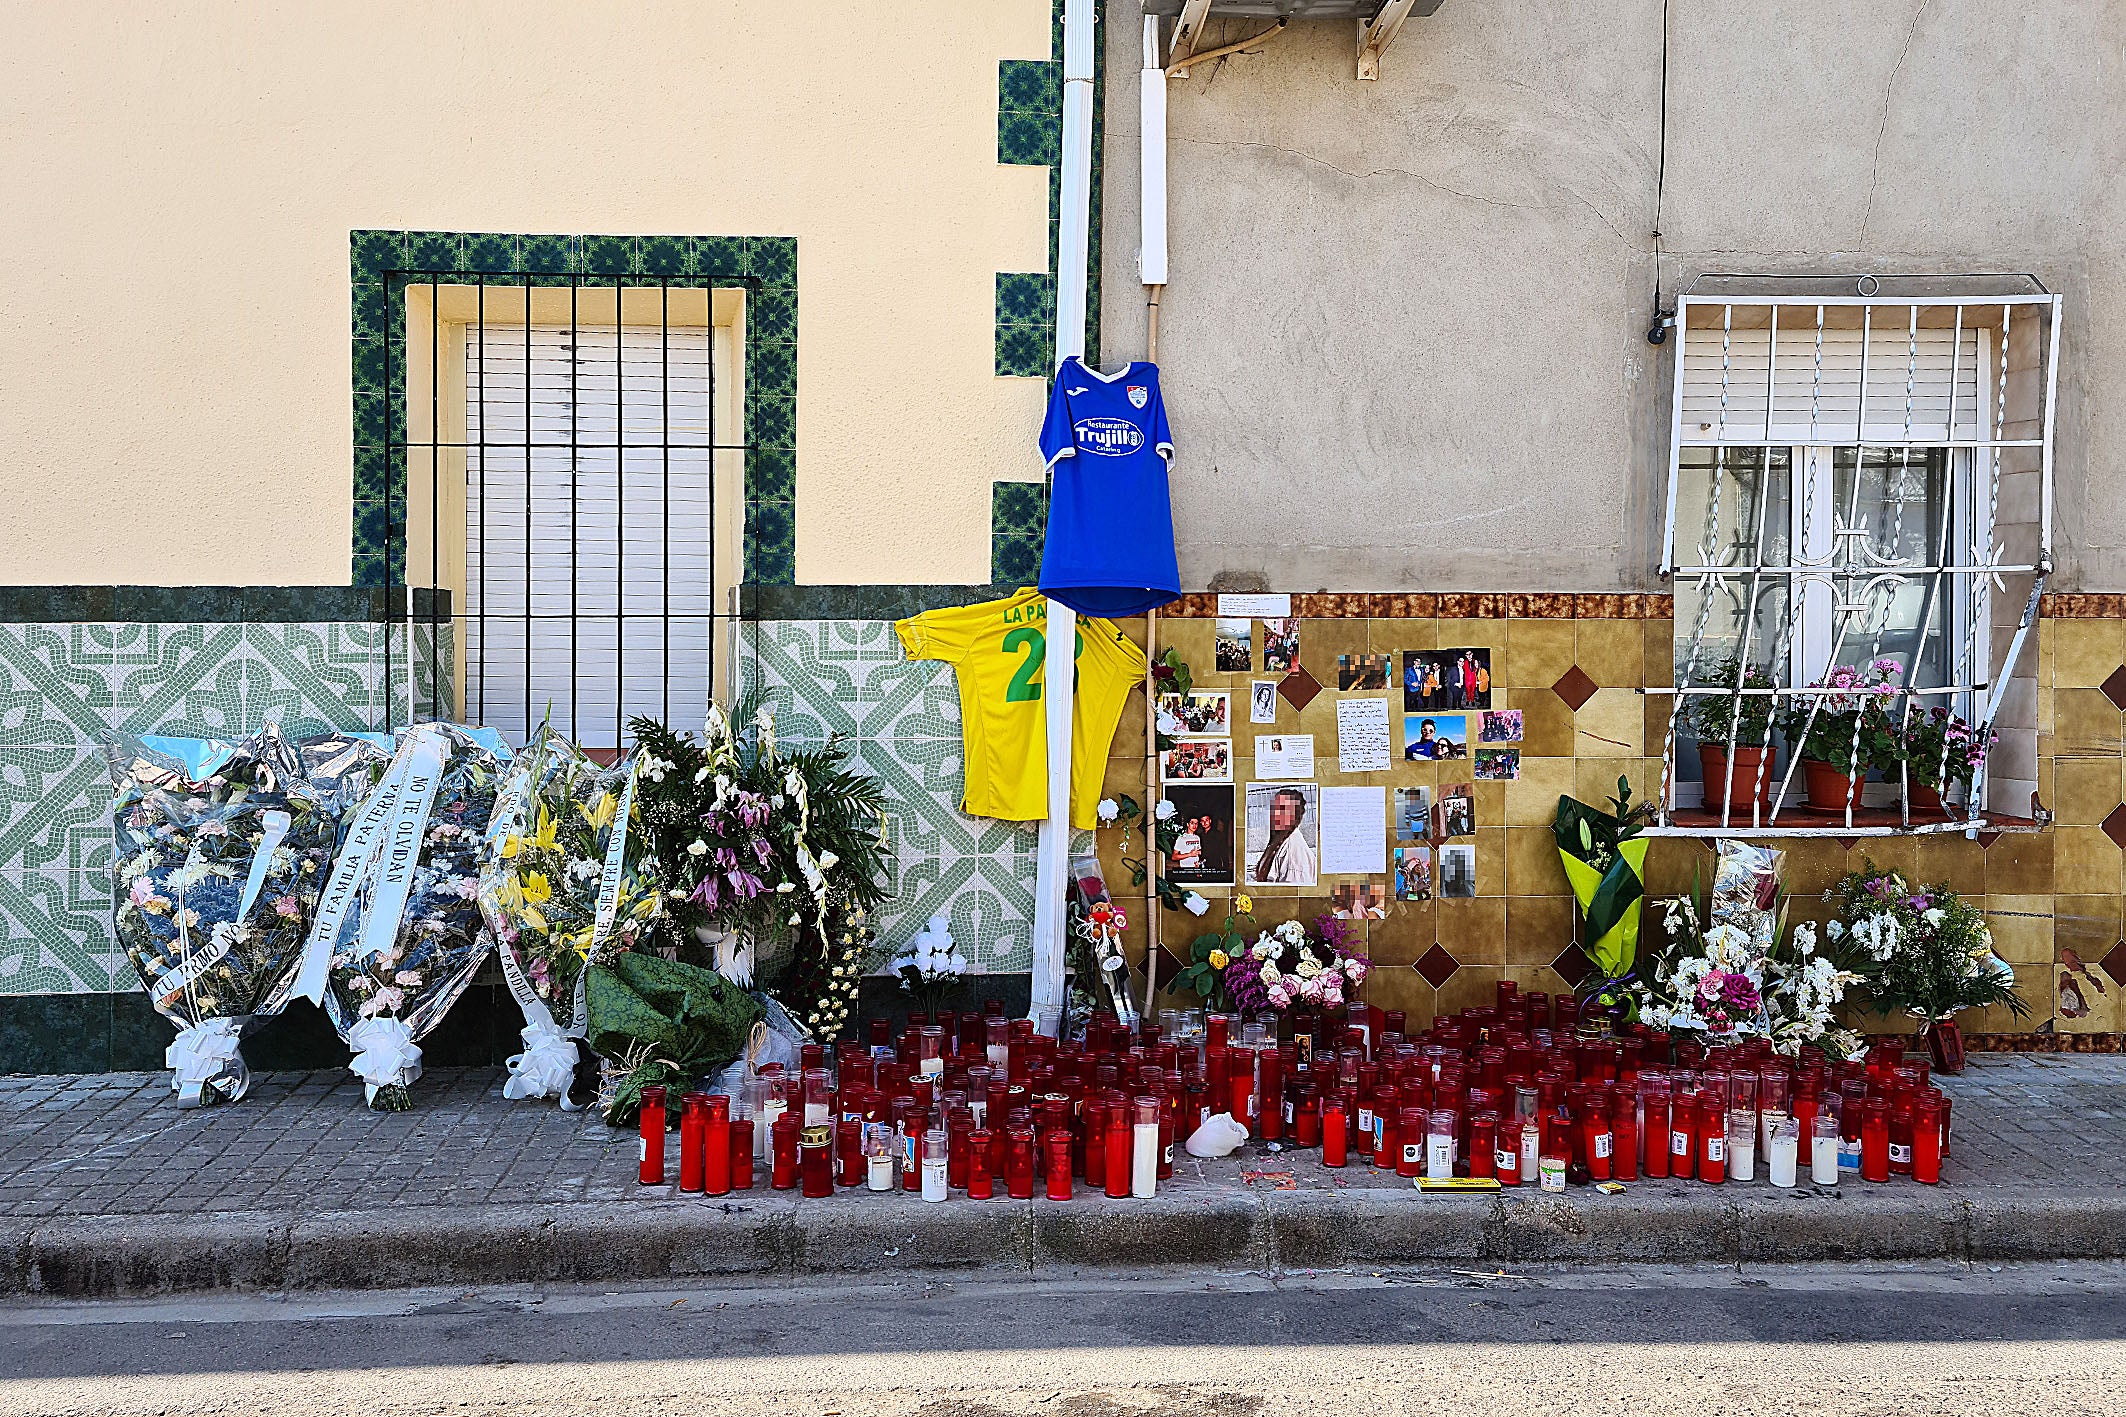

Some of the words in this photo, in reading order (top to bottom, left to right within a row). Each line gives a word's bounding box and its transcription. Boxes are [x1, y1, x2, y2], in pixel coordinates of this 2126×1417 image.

[1087, 420, 1130, 430] Restaurante
[1075, 427, 1141, 448] Trujillo
[1003, 607, 1023, 624] LA
[410, 775, 429, 793] NO
[354, 783, 400, 846] PATERNA
[402, 798, 422, 815] TE
[609, 829, 622, 853] CON
[386, 820, 415, 884] OLVIDAN
[325, 854, 362, 915] FAMILIA
[599, 859, 619, 913] SIEMPRE
[318, 921, 333, 942] TU
[155, 975, 175, 997] TU
[502, 954, 537, 1006] PANDILLA
[575, 990, 584, 1008] TE
[573, 1013, 586, 1029] YO
